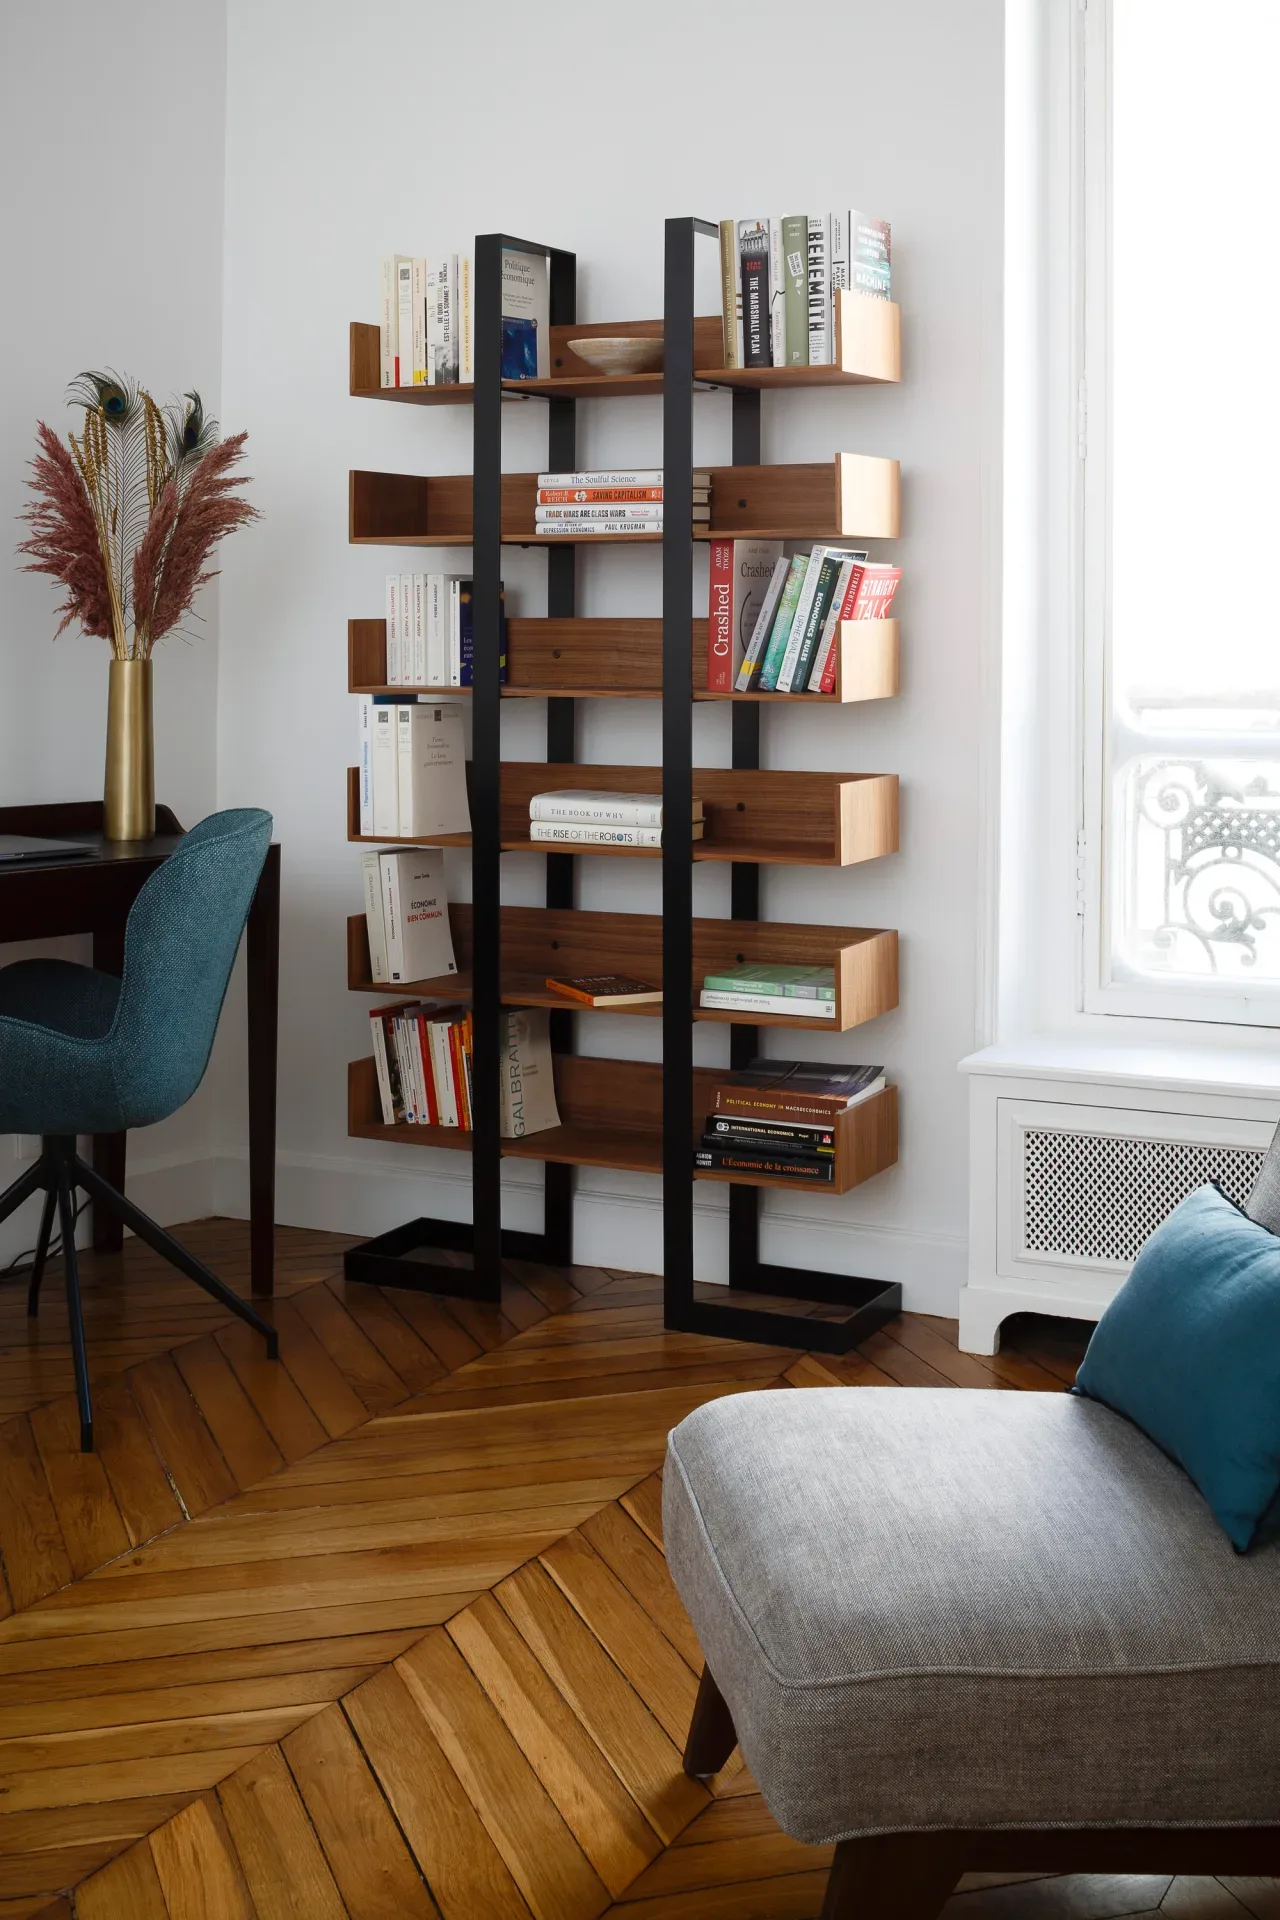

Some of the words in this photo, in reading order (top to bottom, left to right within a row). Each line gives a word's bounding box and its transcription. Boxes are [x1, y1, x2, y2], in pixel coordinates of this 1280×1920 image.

[504, 259, 531, 273] Politique
[501, 270, 535, 286] économique
[749, 277, 759, 290] THE
[808, 231, 825, 333] BEHEMOTH
[856, 271, 887, 290] MACHINE
[438, 316, 443, 324] DE
[444, 309, 450, 317] LA
[750, 292, 760, 333] MARSHALL
[751, 335, 761, 354] PLAN
[570, 476, 584, 484] The
[585, 475, 610, 484] Soulful
[611, 475, 637, 483] Science
[592, 491, 613, 500] SAVING
[613, 490, 647, 499] CAPITALISM
[545, 510, 563, 518] TRADE
[563, 510, 579, 518] WARS
[579, 510, 591, 518] ARE
[591, 510, 609, 518] CLASS
[722, 546, 730, 571] TOOZE
[812, 547, 823, 564] THE
[741, 562, 775, 578] Crashed
[798, 565, 818, 613] GLOBOTICS
[846, 572, 860, 602] STRAIGHT
[860, 580, 899, 597] STRAIGHT
[805, 591, 824, 637] ECONOMICS
[841, 603, 851, 618] TALK
[858, 599, 892, 620] TALK
[713, 583, 730, 657] Crashed
[787, 614, 805, 655] UPHEAVAL
[799, 638, 811, 662] RULES
[550, 808, 566, 816] THE
[568, 809, 591, 817] BOOK
[605, 811, 624, 819] WHY
[537, 828, 552, 838] THE
[553, 829, 569, 839] RISE
[570, 830, 582, 839] OF
[583, 831, 599, 840] THE
[599, 831, 633, 842] ROBOTS
[411, 899, 437, 910] ÉCONOMIE
[407, 915, 419, 923] BIEN
[419, 911, 443, 921] COMMUN
[508, 1013, 526, 1138] GALBRAITH
[726, 1098, 751, 1106] POLITICAL
[753, 1101, 776, 1109] ECONOMY
[785, 1105, 831, 1115] MACROECONOMICS
[730, 1125, 766, 1133] INTERNATIONAL
[696, 1152, 713, 1160] AGHION
[696, 1159, 712, 1167] HOWITT
[722, 1157, 763, 1169] L'Économie
[764, 1161, 773, 1170] de
[774, 1162, 782, 1171] la
[782, 1164, 819, 1175] croissance
